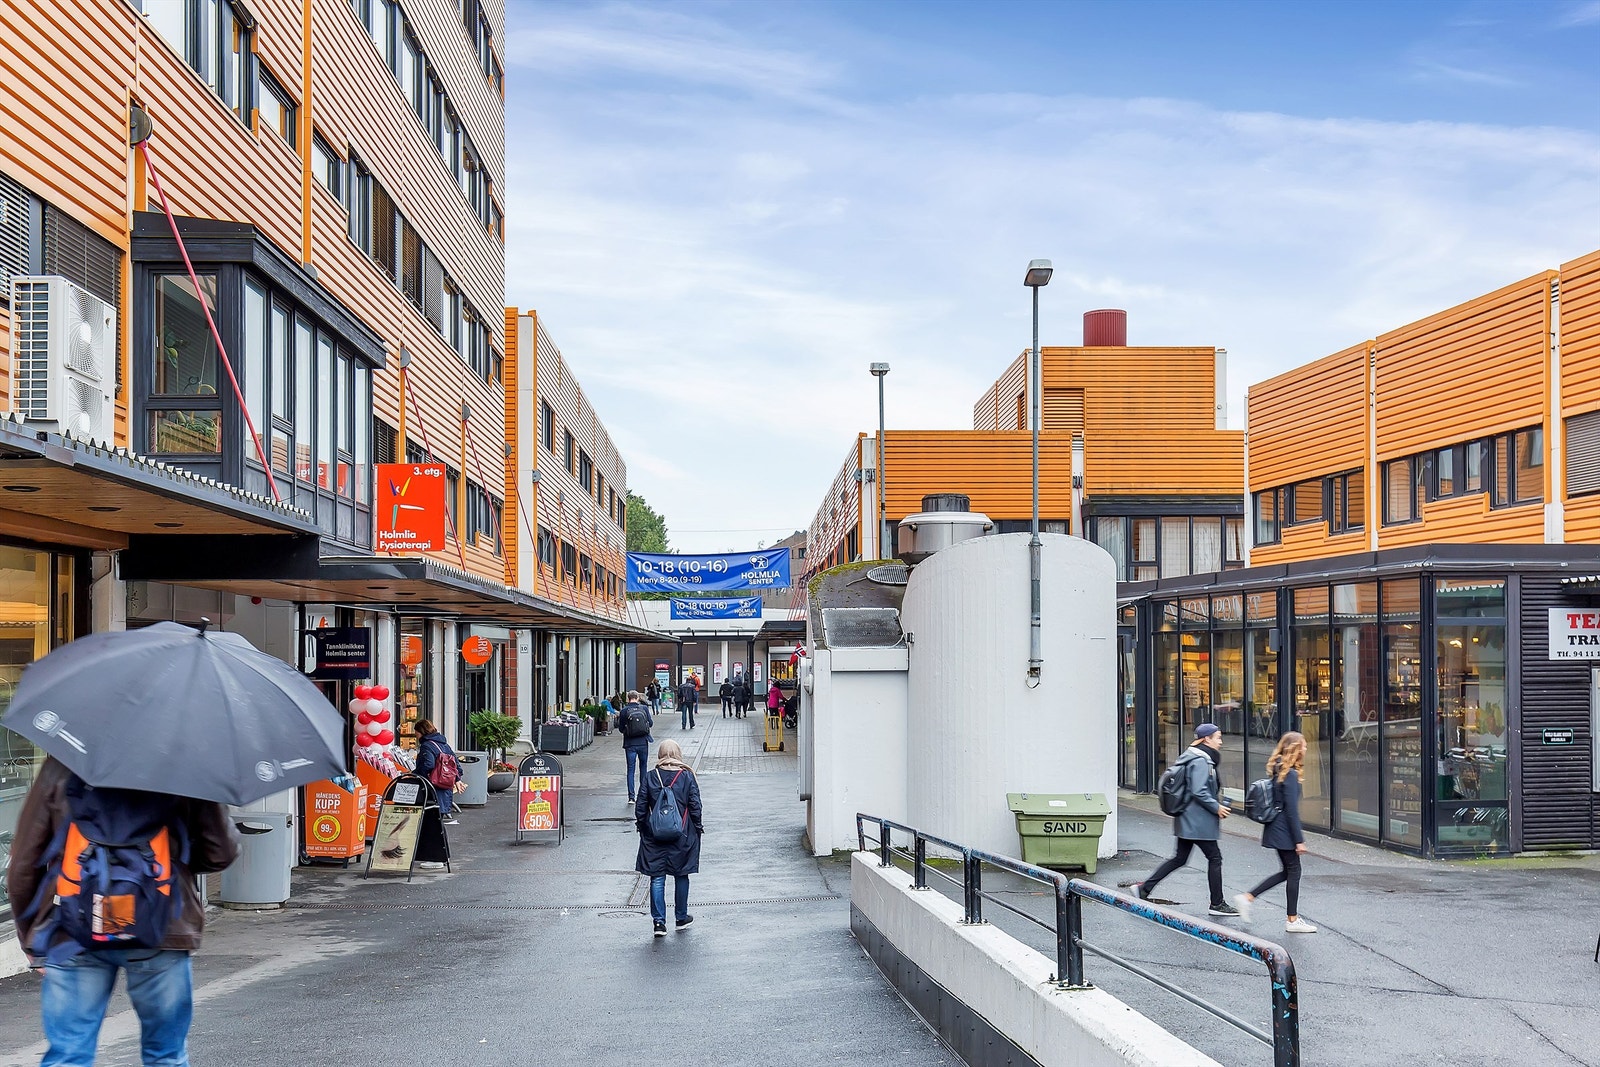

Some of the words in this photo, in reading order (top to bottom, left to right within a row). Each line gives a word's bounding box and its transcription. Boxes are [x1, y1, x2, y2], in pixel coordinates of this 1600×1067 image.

[413, 467, 422, 475] 3.
[424, 467, 443, 477] etg.
[379, 530, 417, 539] Holmlia
[379, 540, 431, 551] Fysioterapi
[635, 560, 674, 573] 10-18
[678, 559, 729, 574] (10-16)
[741, 570, 781, 579] HOLMLIA
[637, 576, 658, 585] Meny
[659, 576, 679, 584] 8-20
[679, 575, 702, 584] (9-19)
[748, 577, 774, 585] SENTER
[675, 602, 697, 610] 10-18
[699, 601, 728, 610] (10-16)
[315, 798, 341, 810] KUPP
[526, 814, 551, 827] -50%
[1043, 822, 1087, 833] SAND
